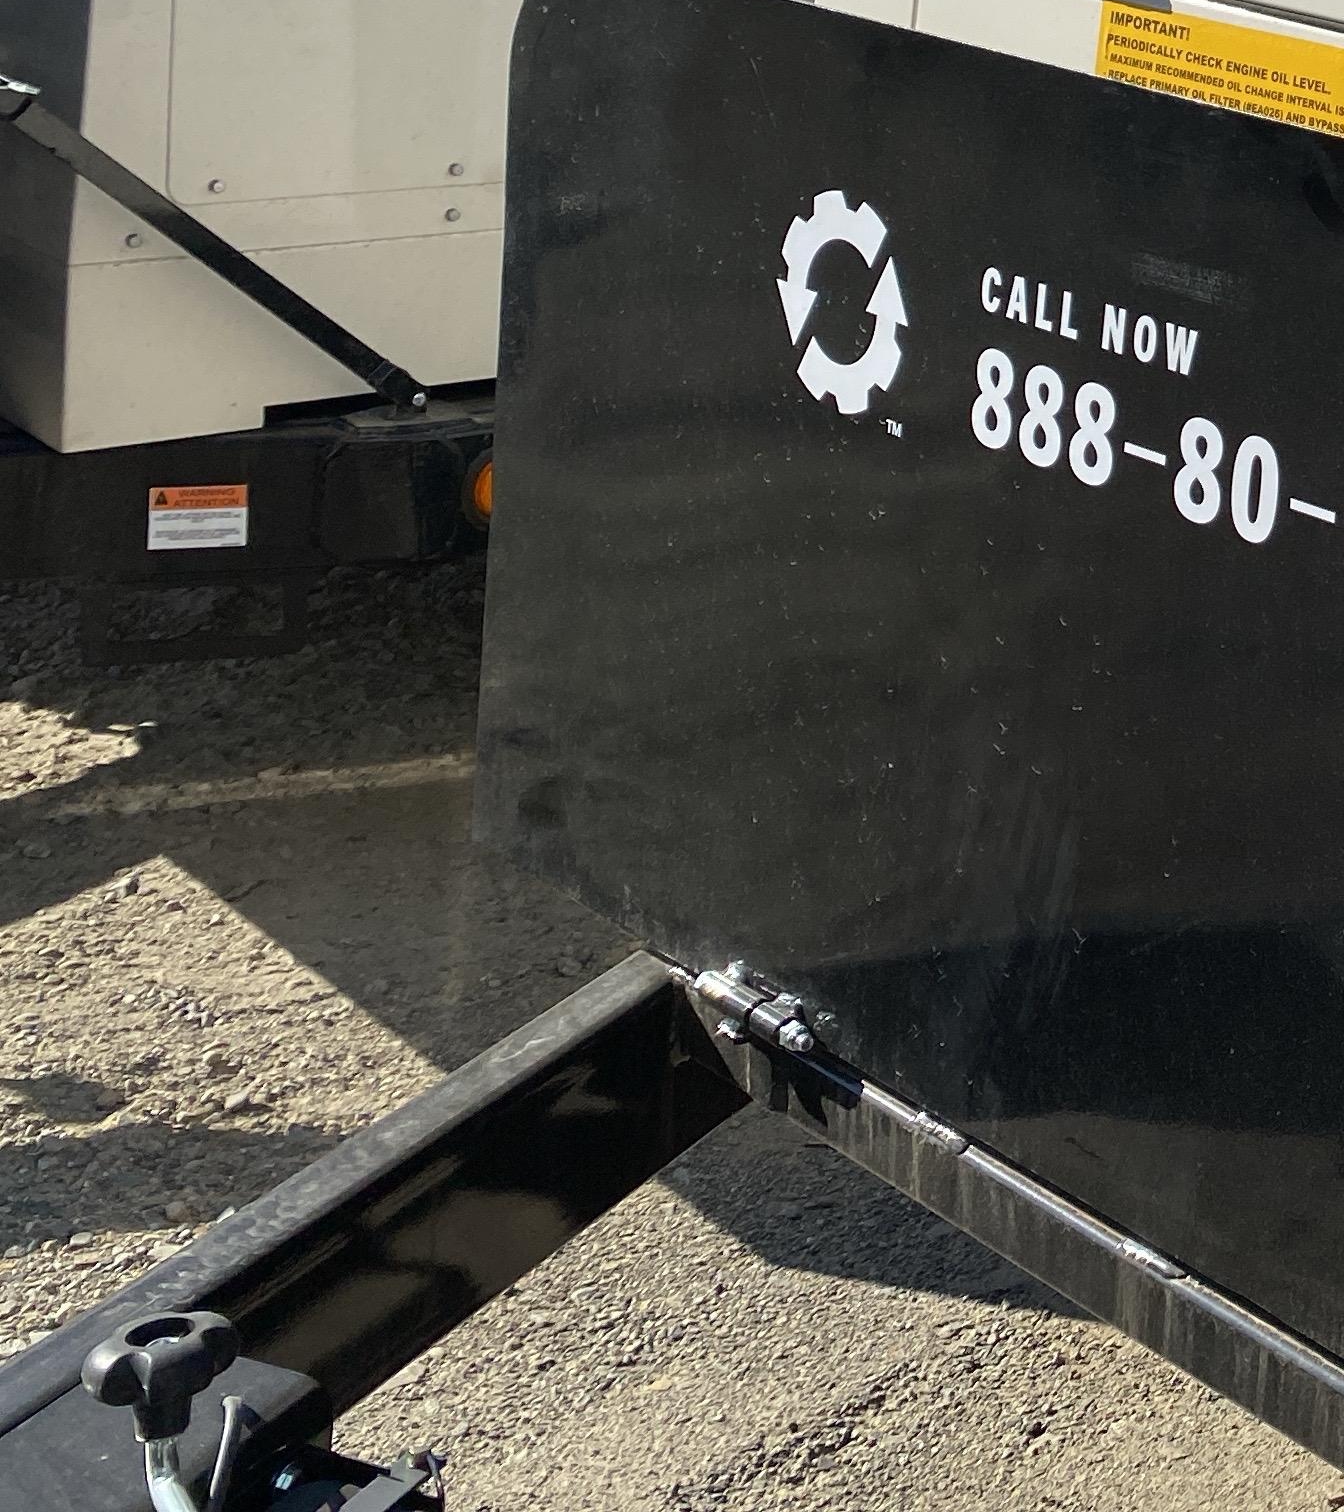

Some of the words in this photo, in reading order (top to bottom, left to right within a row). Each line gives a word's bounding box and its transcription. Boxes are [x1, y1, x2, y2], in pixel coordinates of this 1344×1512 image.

[1109, 10, 1191, 41] IMPORTANT!
[1107, 33, 1184, 61] PERIODICALLY
[1185, 51, 1224, 70] CHECK
[1225, 61, 1269, 80] ENGINE
[1271, 71, 1289, 86] OIL
[1293, 75, 1332, 95] LEVEL.
[1109, 52, 1153, 71] MAXIMUM
[1155, 63, 1225, 89] RECOMMENDED
[1226, 80, 1242, 93] OIL
[1244, 84, 1284, 103] CHANGE
[1286, 93, 1332, 114] INTERVAL
[1335, 105, 1344, 117] IS
[1108, 69, 1147, 87] REPLACE
[1150, 79, 1190, 97] PRIMARY
[1191, 89, 1207, 101] OIL
[1209, 93, 1241, 110] FILTER
[1286, 112, 1306, 125] AND
[980, 265, 1079, 342] CALL
[1100, 302, 1200, 377] NOW
